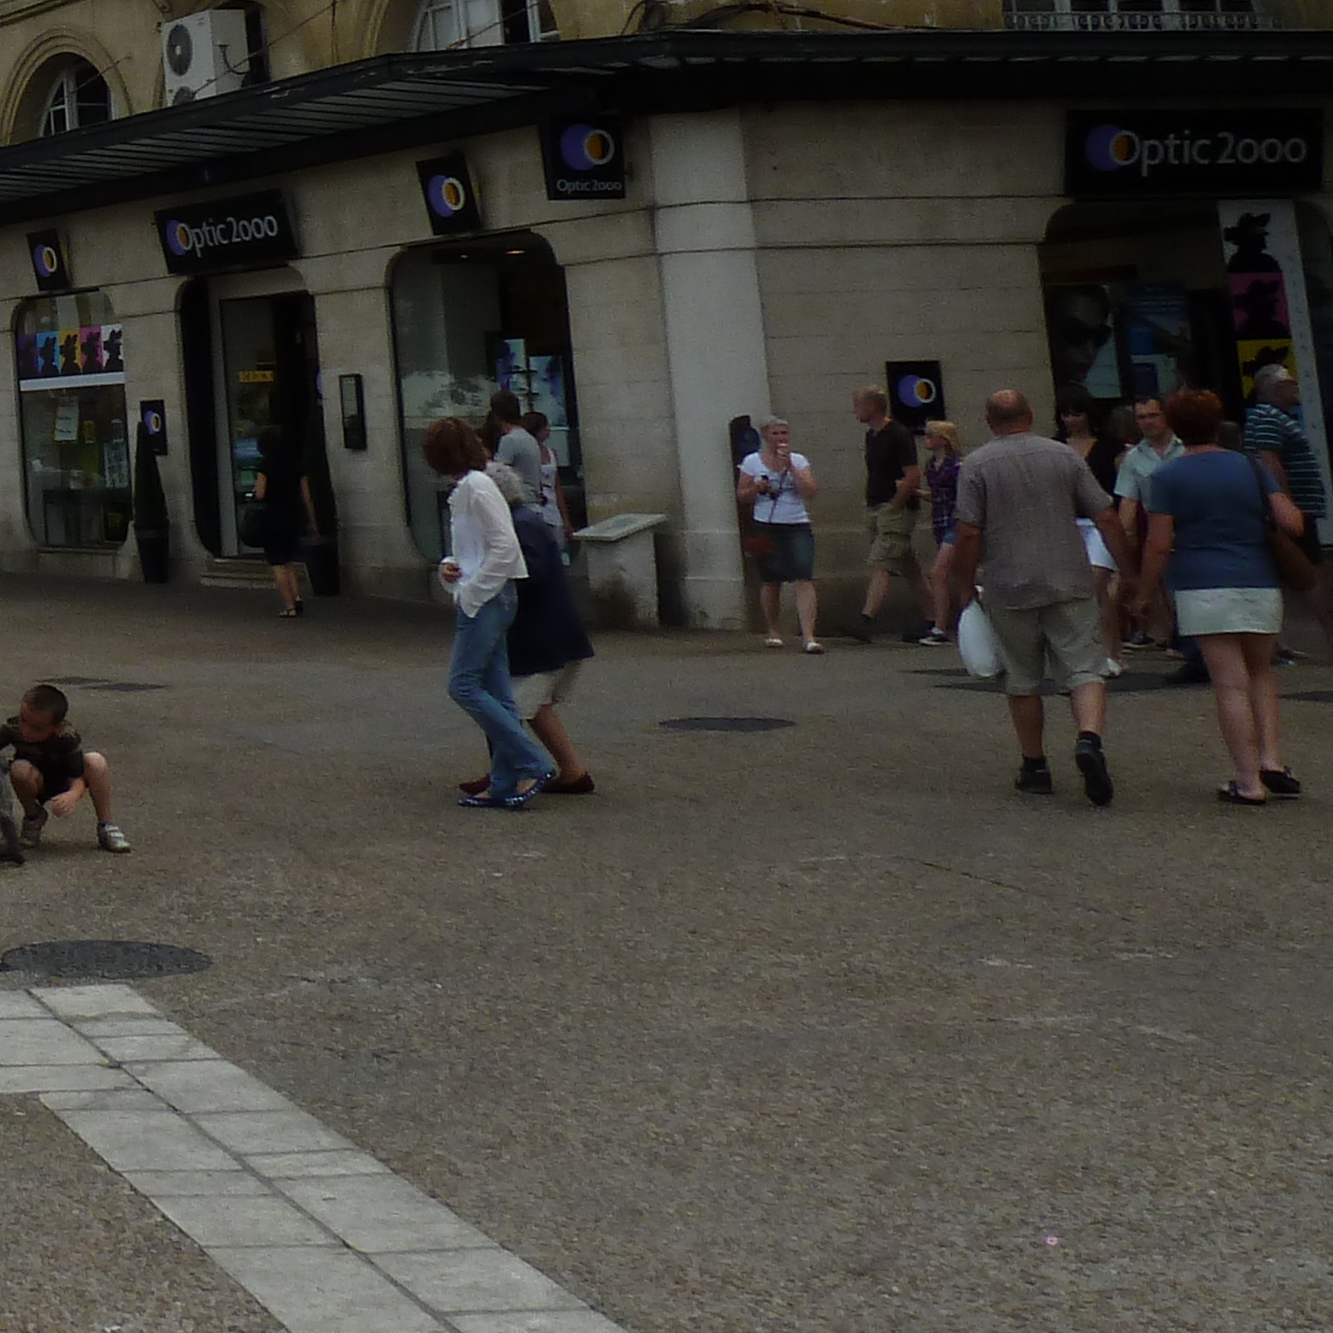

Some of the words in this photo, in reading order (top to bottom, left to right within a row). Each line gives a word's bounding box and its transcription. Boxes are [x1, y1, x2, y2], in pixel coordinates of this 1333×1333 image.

[1109, 129, 1213, 177] Optic
[1216, 131, 1308, 165] 2000
[556, 179, 590, 194] Optic
[592, 179, 622, 191] 2000
[176, 218, 230, 258] Optic
[226, 216, 278, 242] 2000
